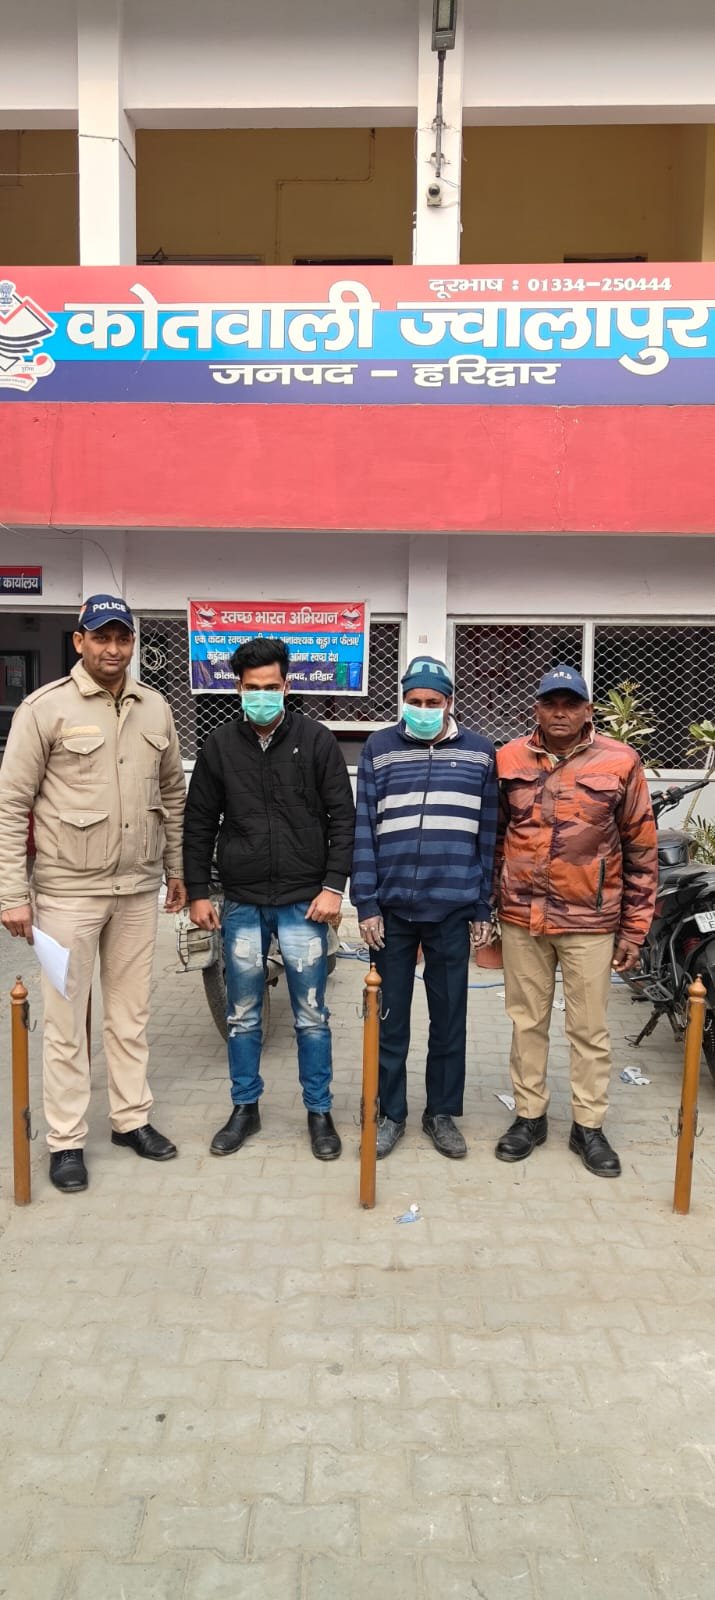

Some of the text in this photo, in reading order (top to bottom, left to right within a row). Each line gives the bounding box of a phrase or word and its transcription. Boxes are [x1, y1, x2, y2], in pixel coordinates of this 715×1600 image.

[429, 278, 504, 298] दूरभाष
[528, 277, 672, 292] 01334-250444
[64, 280, 715, 376] कोतवाली ज्वालापुर
[208, 363, 358, 385] जनपद
[412, 354, 562, 387] हरिद्वार
[3, 572, 39, 589] कार्यालय
[92, 601, 127, 613] POLICE
[221, 606, 338, 625] स्वच्छ भारत अभियान
